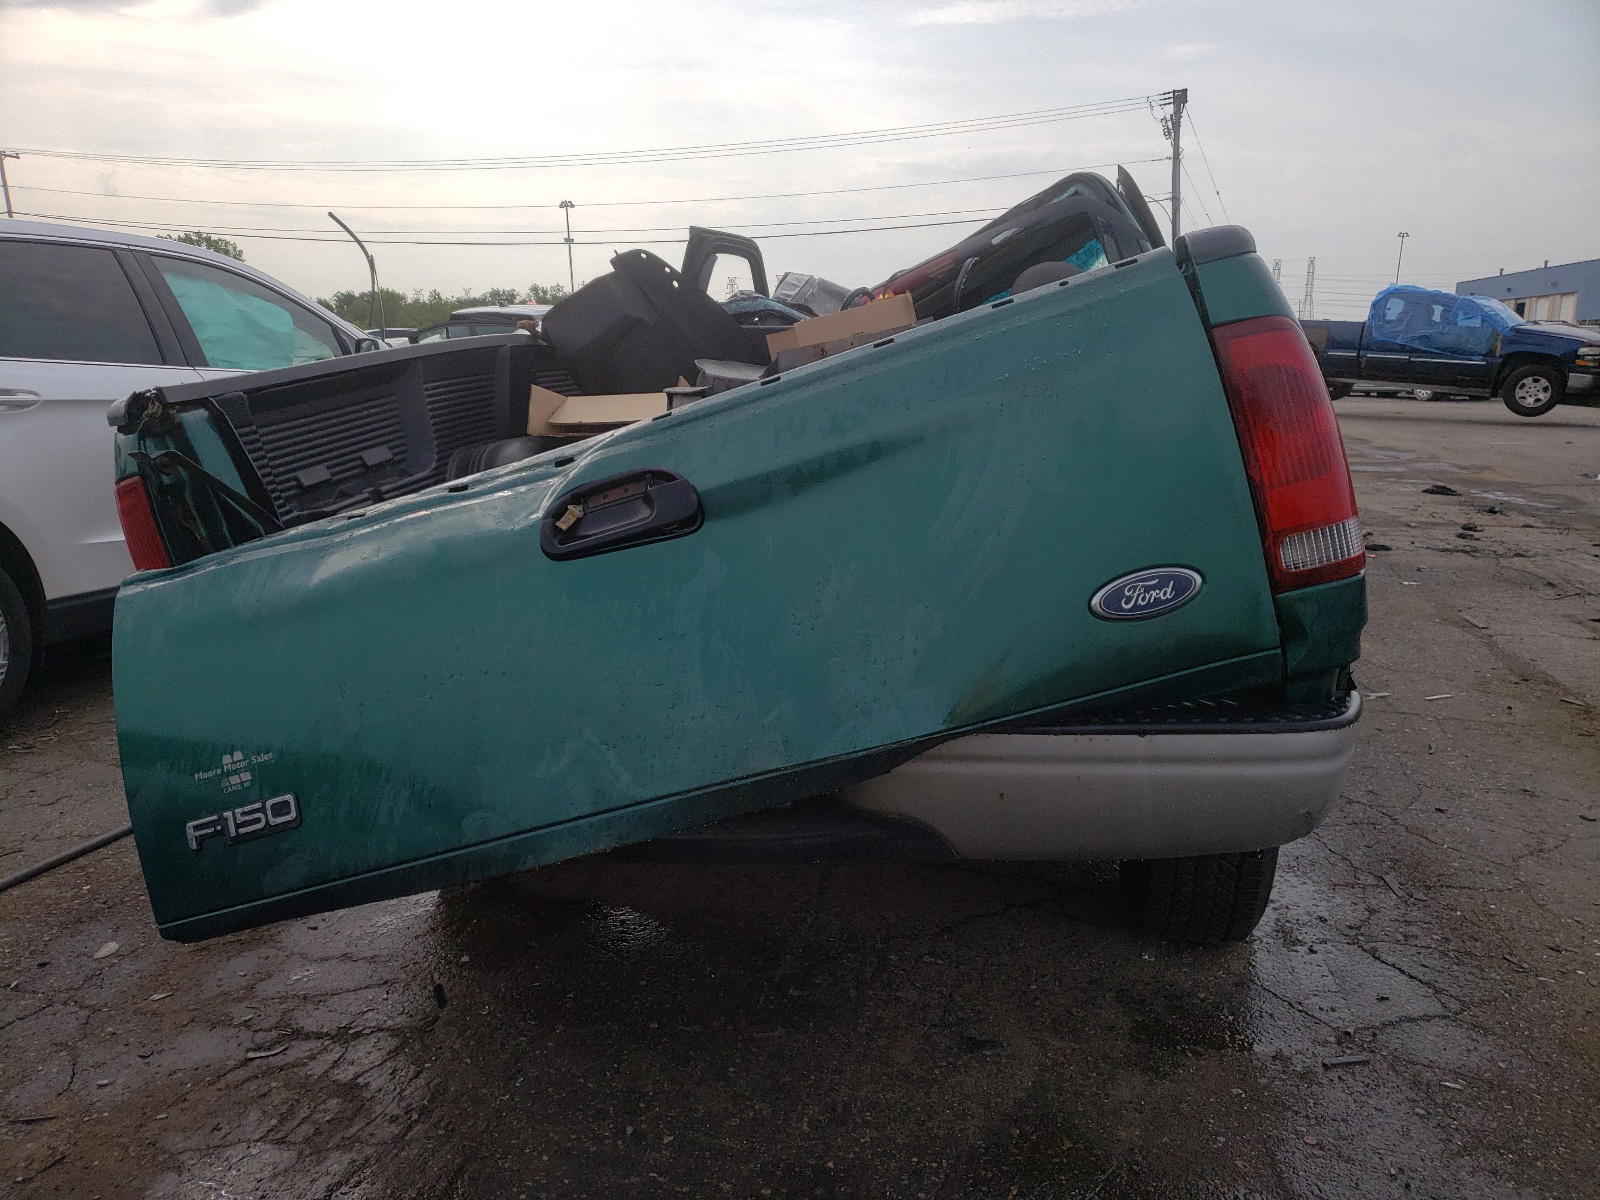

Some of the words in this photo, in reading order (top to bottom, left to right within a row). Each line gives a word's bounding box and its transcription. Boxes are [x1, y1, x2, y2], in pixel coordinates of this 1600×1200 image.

[1121, 578, 1175, 609] Ford
[194, 767, 222, 781] Moore
[223, 759, 249, 773] Motor
[251, 752, 273, 764] Sales
[186, 794, 297, 850] F-150
